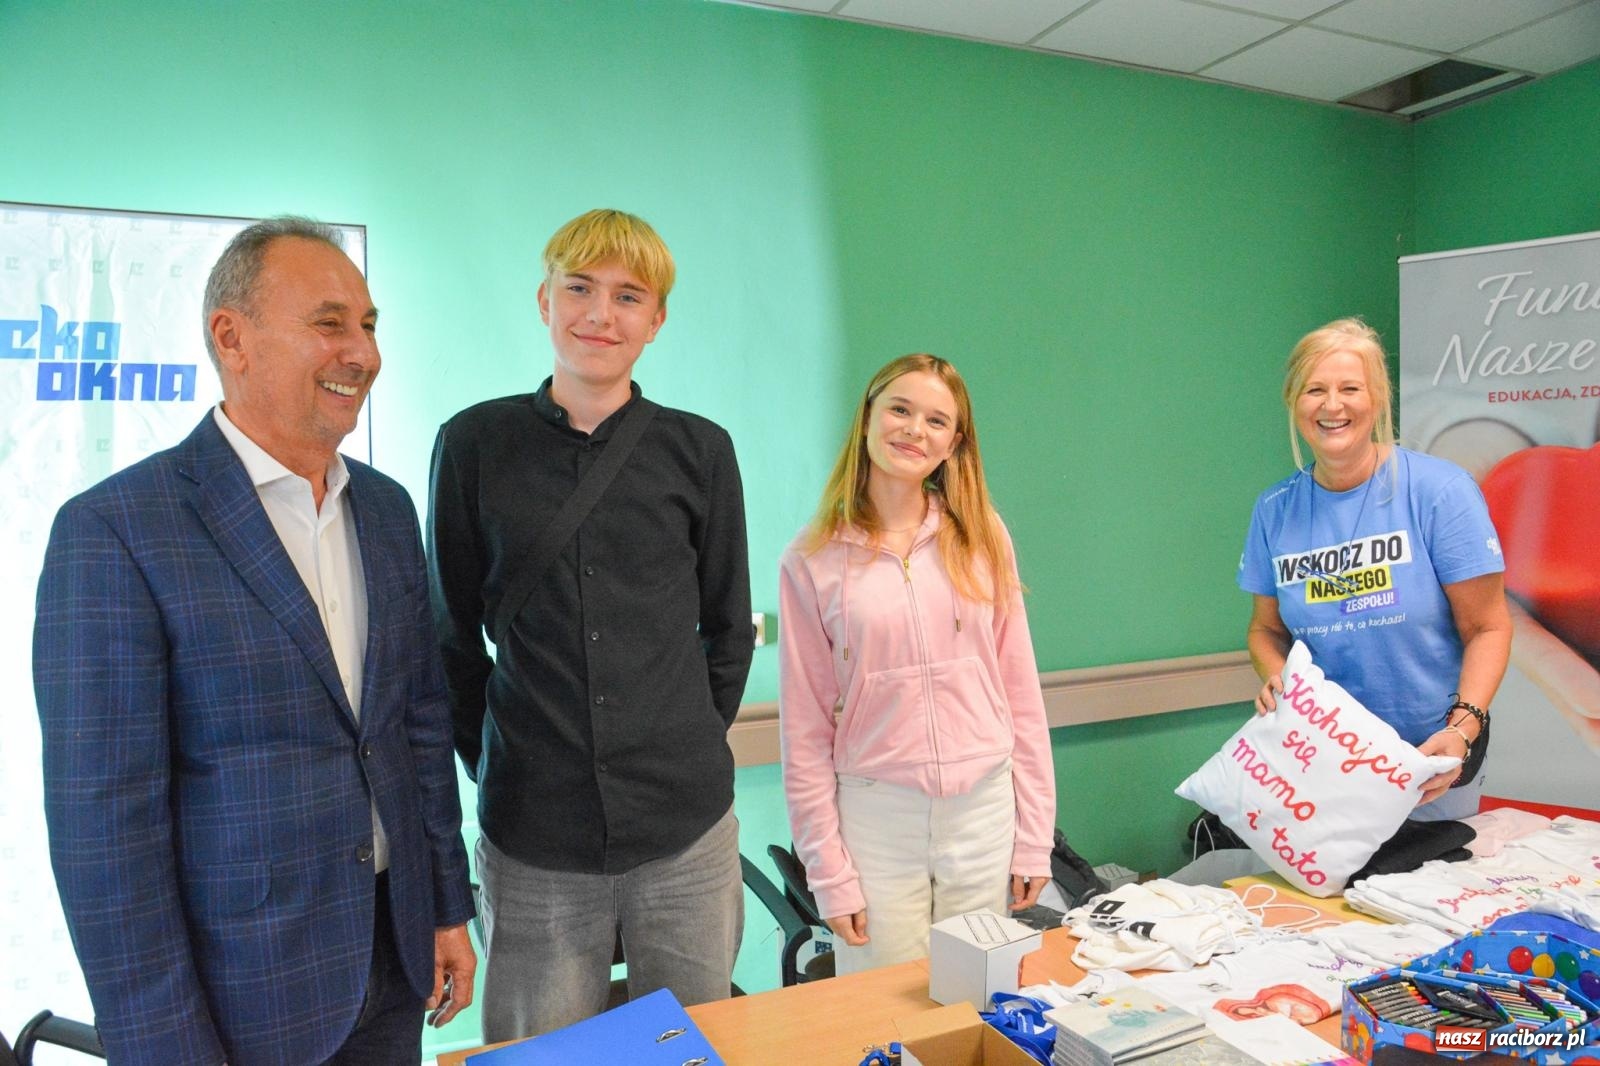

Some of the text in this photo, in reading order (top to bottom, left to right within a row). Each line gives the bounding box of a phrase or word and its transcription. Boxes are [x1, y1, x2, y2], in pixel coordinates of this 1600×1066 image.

[1478, 271, 1600, 326] Fun
[36, 362, 197, 401] okna
[1432, 330, 1596, 386] Nasze
[1488, 387, 1576, 403] EDUKACJA,
[1278, 535, 1403, 583] WSKOCZ DO
[1311, 568, 1387, 599] NASZEGO
[1346, 591, 1395, 613] ZESPOŁU!
[1282, 729, 1320, 773] się
[1283, 673, 1412, 790] Kochajcie
[1232, 738, 1316, 821] mamo
[1247, 809, 1327, 886] i tato
